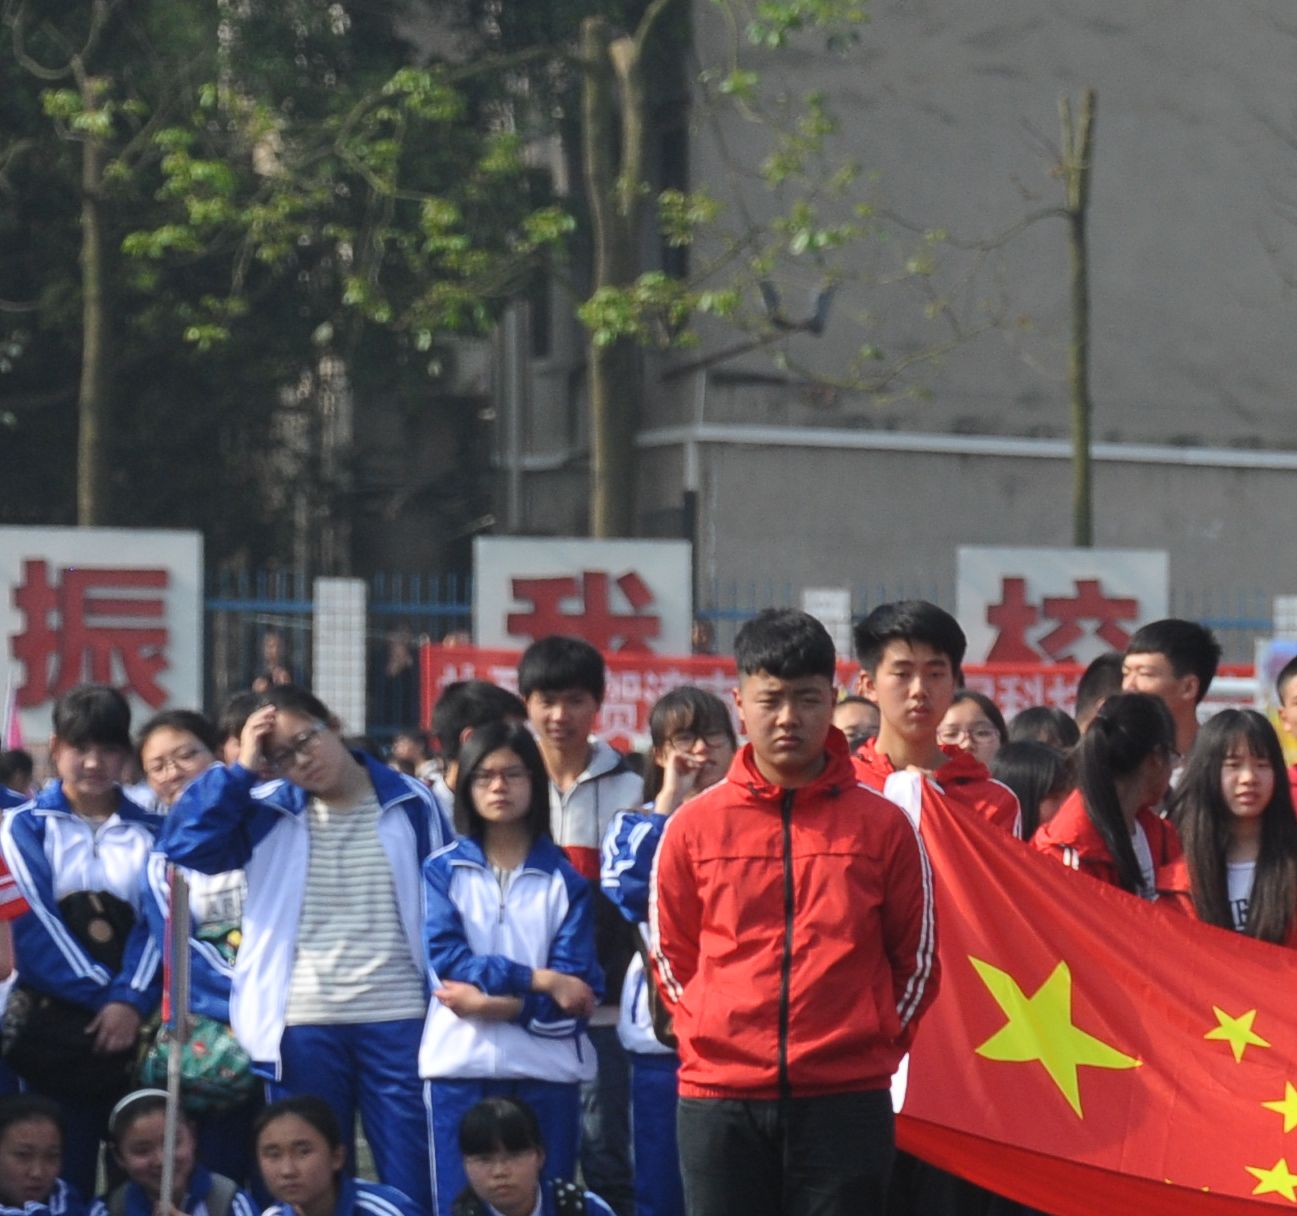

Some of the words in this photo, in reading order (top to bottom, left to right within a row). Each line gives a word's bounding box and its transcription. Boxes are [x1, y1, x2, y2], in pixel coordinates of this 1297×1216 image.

[10, 559, 170, 711] 振
[506, 570, 662, 658] 我
[986, 576, 1139, 664] 校
